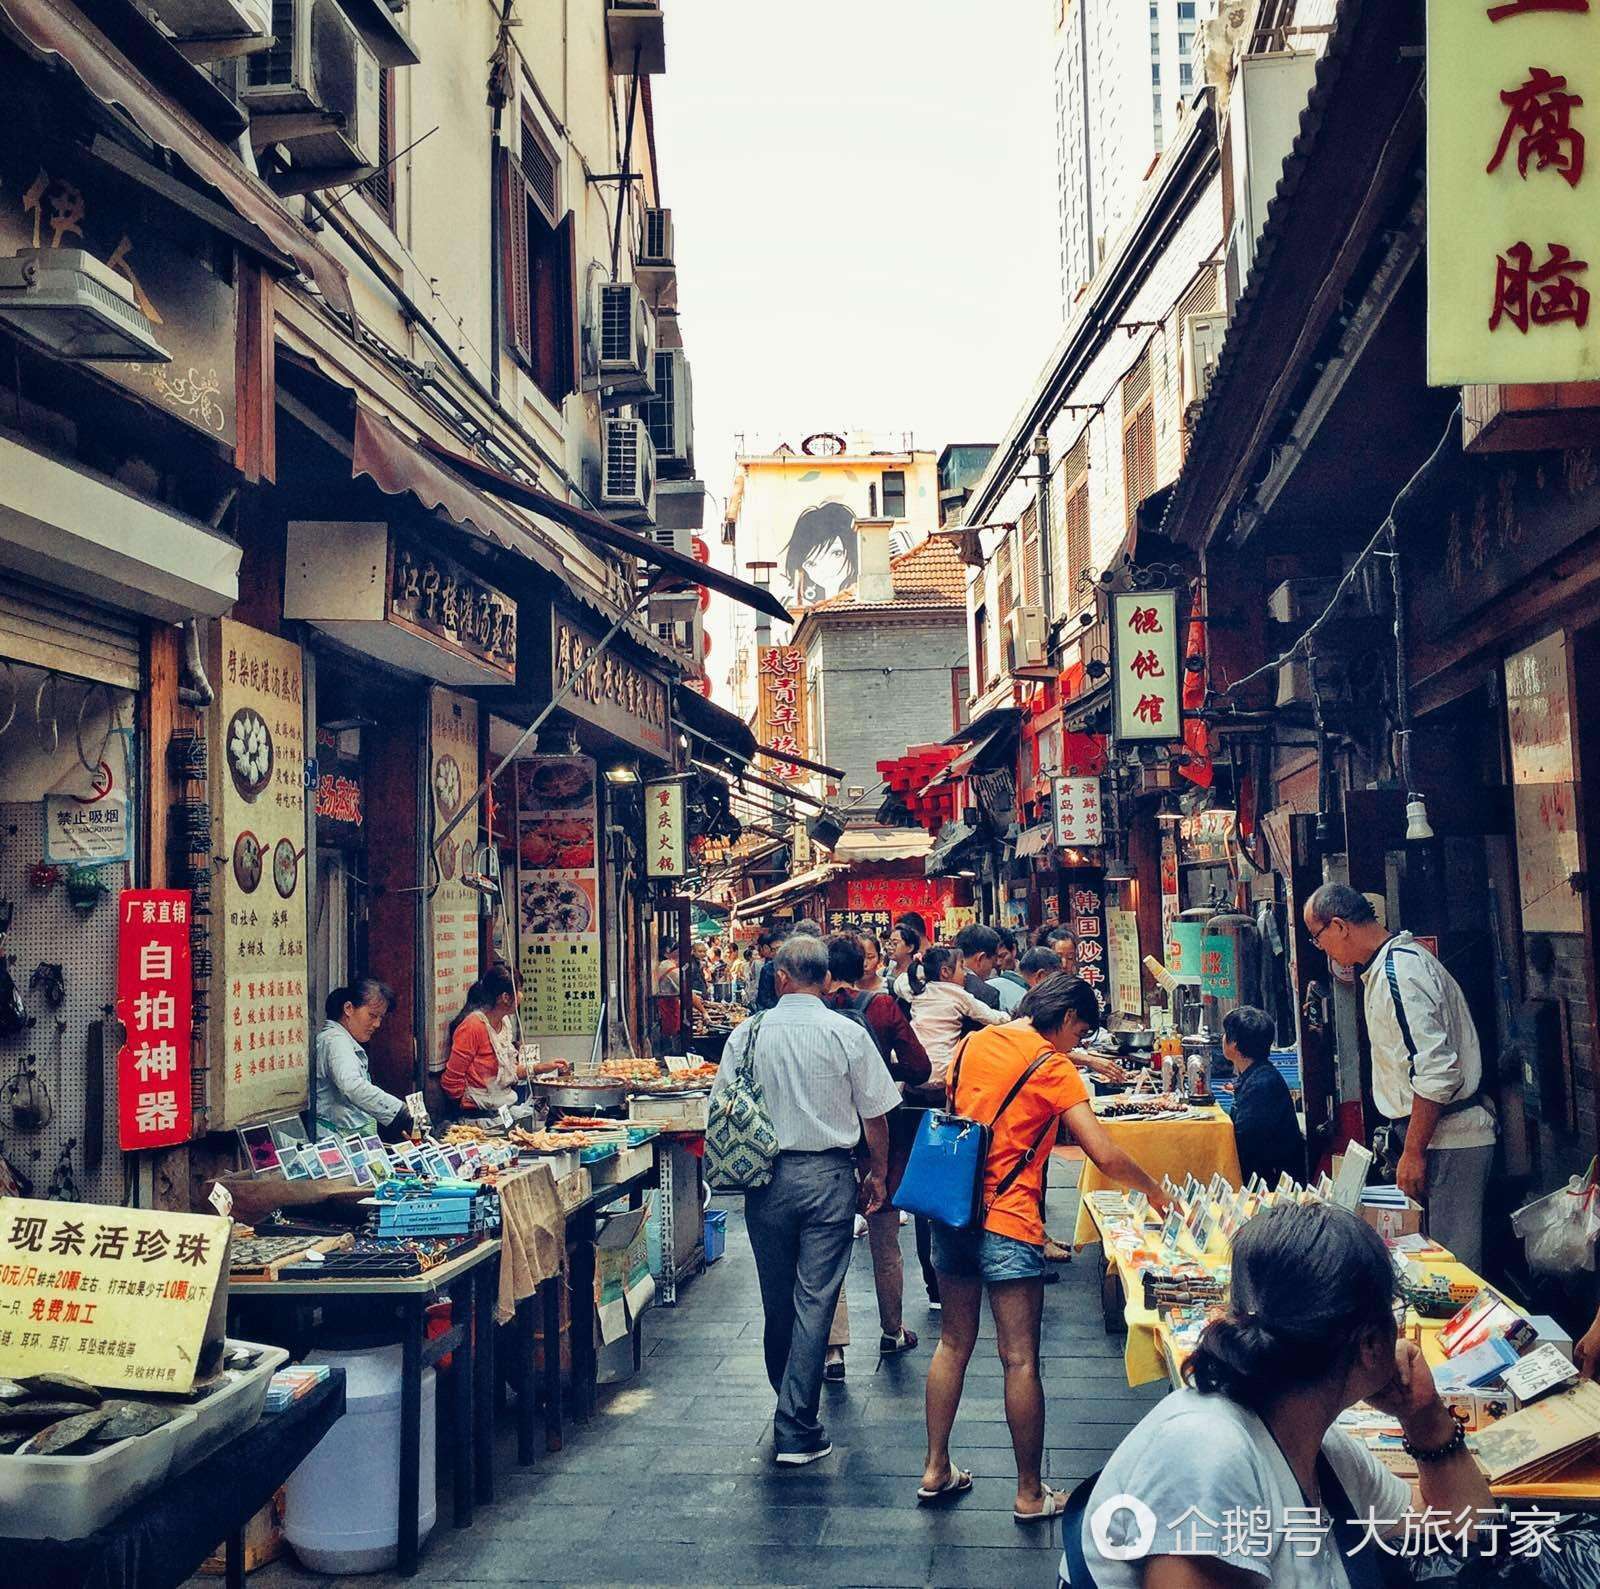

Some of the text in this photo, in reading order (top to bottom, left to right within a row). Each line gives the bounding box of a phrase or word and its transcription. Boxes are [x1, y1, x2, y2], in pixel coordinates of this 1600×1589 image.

[1485, 0, 1591, 334] 腐脑
[759, 648, 806, 675] 麦子
[1128, 604, 1166, 726] 馄饨馆
[57, 809, 119, 826] 禁止吸烟
[656, 788, 674, 873] 重庆火锅
[1059, 783, 1076, 841] 青岛特色
[1082, 782, 1098, 840] 海鲜炒菜
[125, 899, 187, 925] 厂家直销
[830, 911, 890, 926] 老北京味
[132, 940, 179, 1133] 自拍神器
[7, 1216, 210, 1267] 现杀活珍珠
[28, 1297, 98, 1325] 免费加工
[124, 1364, 178, 1382] 另收材料费
